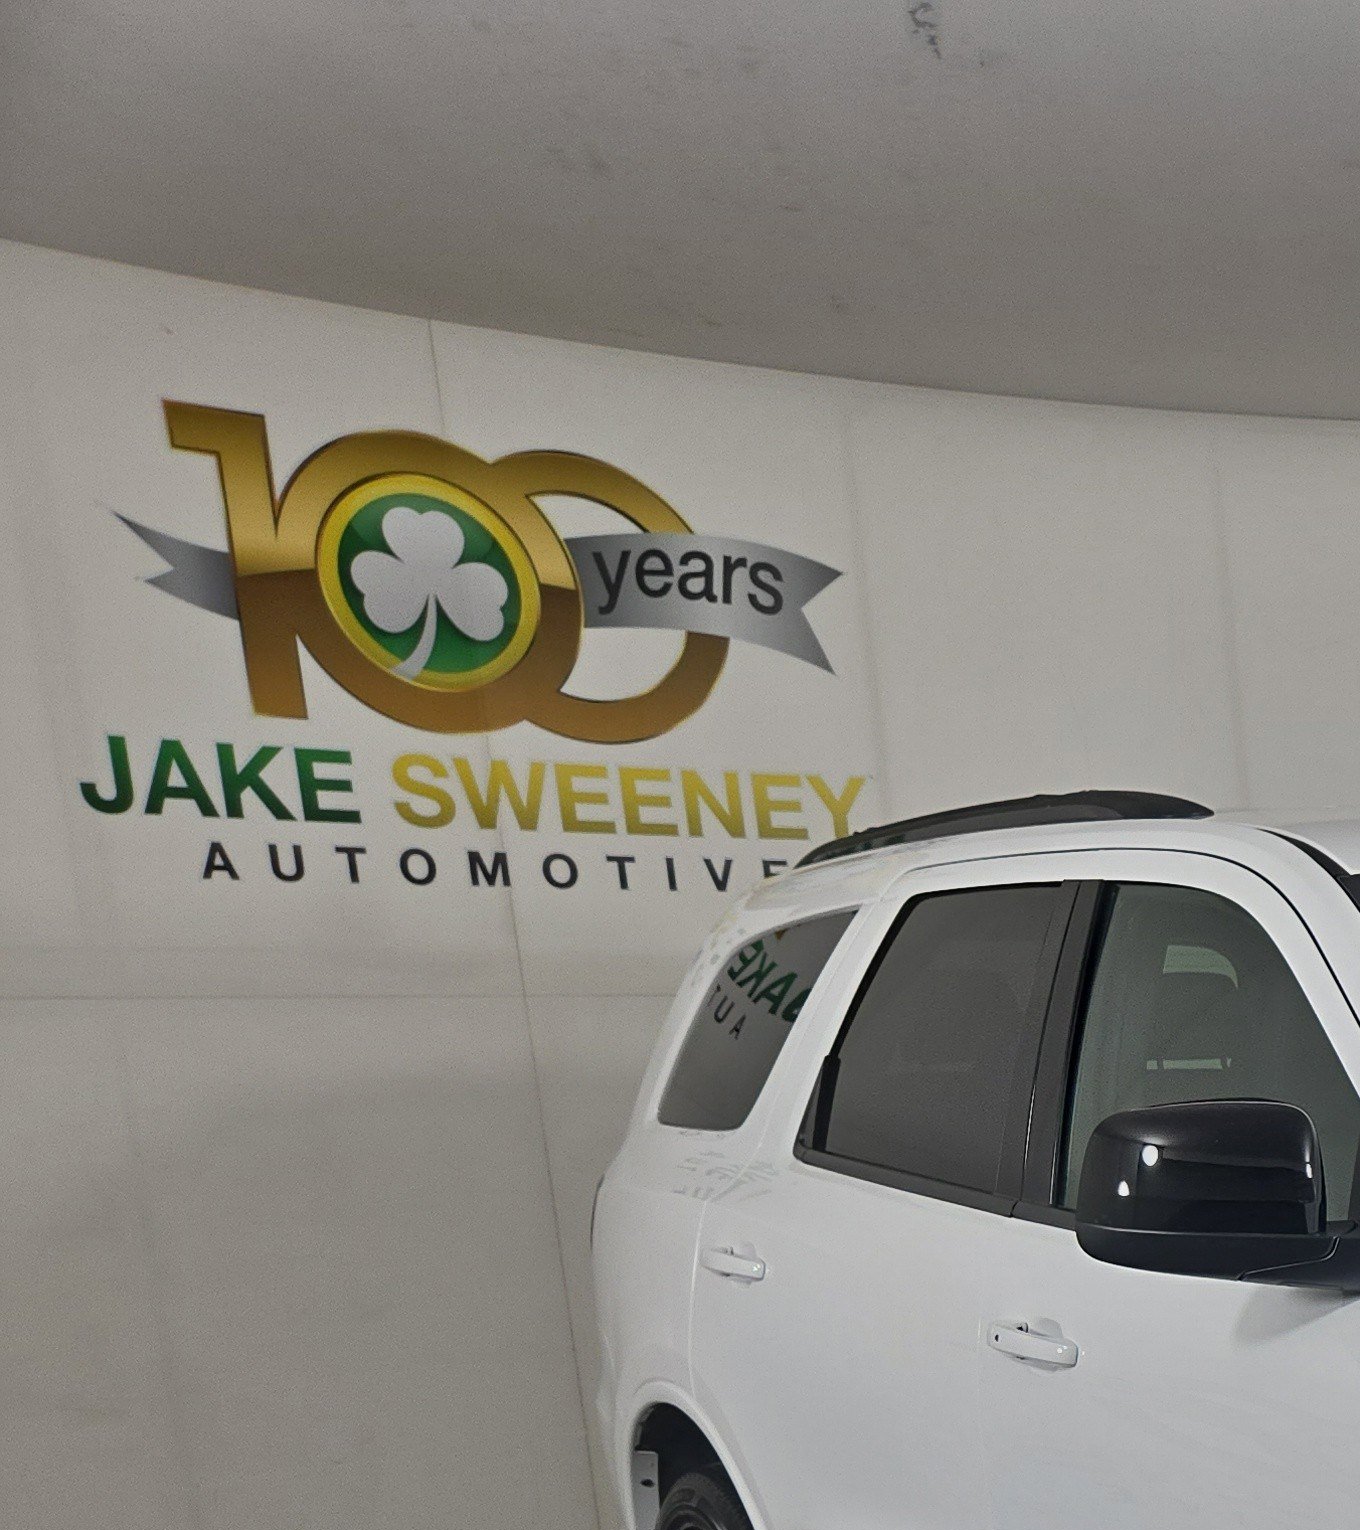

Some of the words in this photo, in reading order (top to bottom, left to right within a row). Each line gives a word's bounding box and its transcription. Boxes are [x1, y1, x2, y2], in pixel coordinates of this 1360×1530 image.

[161, 399, 730, 745] 100
[592, 543, 786, 615] years
[79, 734, 363, 825] JAKE
[390, 753, 867, 841] SWEENEY
